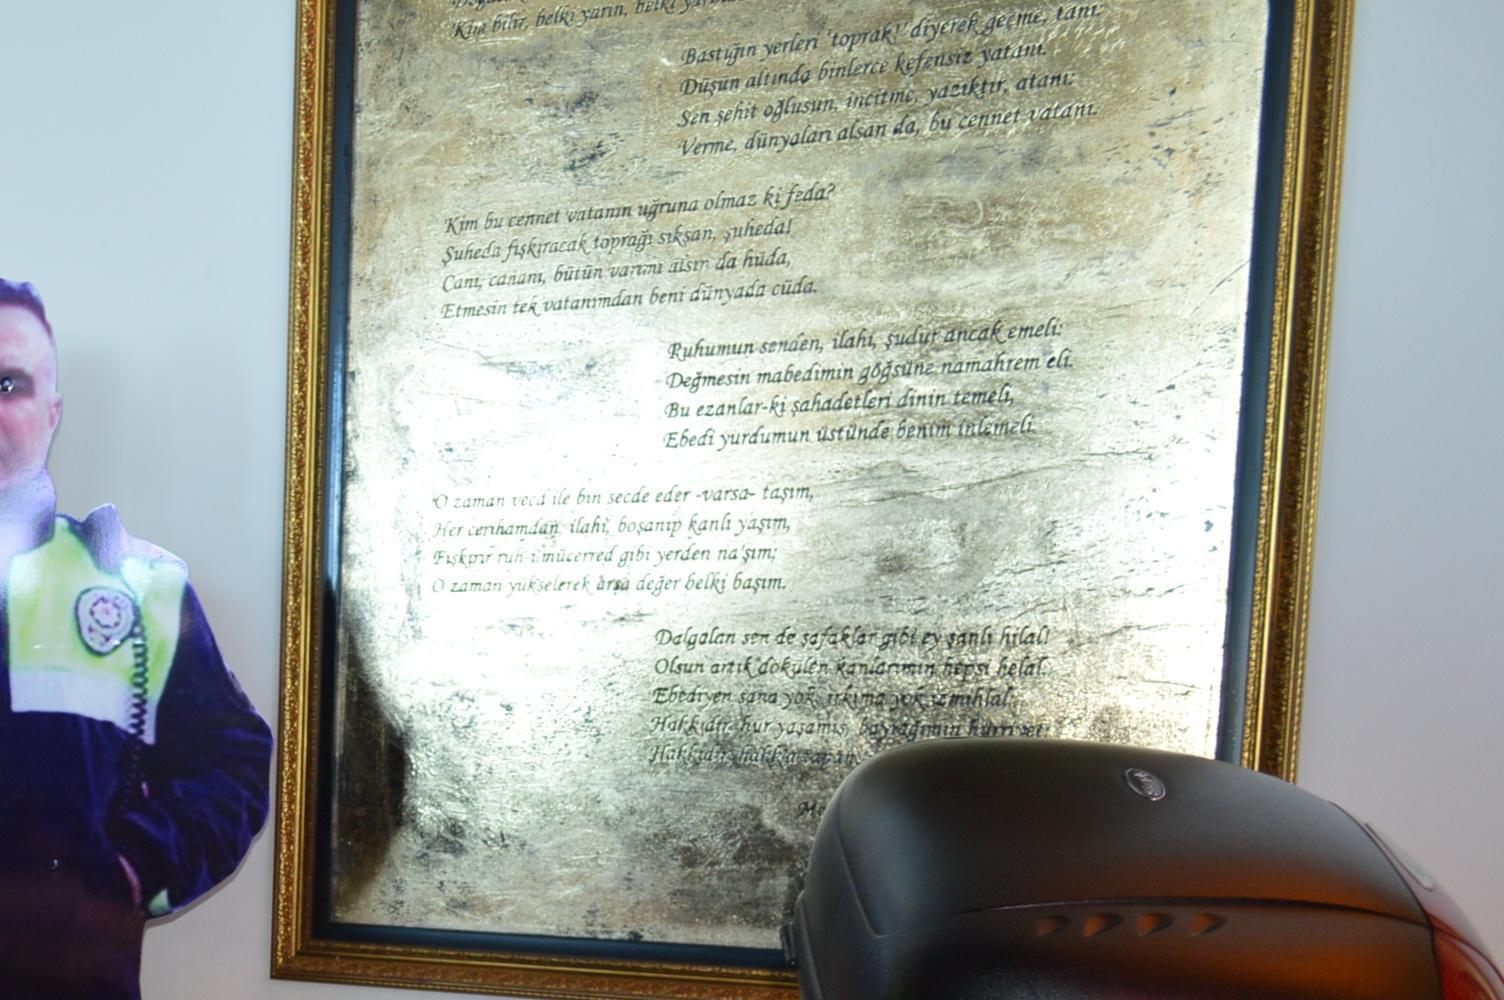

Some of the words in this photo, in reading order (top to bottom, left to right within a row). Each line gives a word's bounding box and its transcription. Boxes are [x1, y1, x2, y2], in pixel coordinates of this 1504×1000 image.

[680, 46, 757, 67] Bastığın
[762, 32, 819, 62] yerleri
[910, 12, 987, 43] diyerek
[981, 10, 1048, 35] geçme,
[680, 76, 740, 97] Düşün
[746, 62, 811, 88] altında
[818, 55, 889, 81] binlerce
[896, 49, 973, 77] kefensiz
[977, 42, 1046, 68] yatanı.
[677, 107, 710, 128] Sen
[715, 99, 757, 128] şehit
[763, 94, 838, 123] oğlusun,
[926, 75, 1009, 107] yazıktır,
[680, 137, 737, 156] Verme,
[745, 129, 832, 153] dünyaları
[837, 118, 886, 142] alsan
[893, 114, 920, 136] da,
[929, 110, 952, 132] bu
[958, 106, 1021, 130] cennet
[1028, 99, 1098, 121] vatanı.
[445, 215, 478, 235] Kim
[484, 211, 503, 231] bu
[508, 209, 560, 228] cennet
[566, 205, 632, 223] vatanın
[638, 198, 697, 222] uğruna
[703, 190, 757, 211] olmaz
[763, 185, 784, 210] ki
[781, 181, 836, 210] feda?
[442, 240, 501, 266] Şuheda
[500, 232, 591, 263] fışkıracak
[592, 229, 653, 254] toprağı
[657, 225, 716, 247] sıksan,
[723, 216, 793, 244] şuheda!
[553, 264, 603, 283] bütün
[714, 250, 737, 271] da
[440, 300, 507, 320] Etmesin
[513, 295, 541, 317] tek
[543, 289, 644, 312] vatanımdan
[648, 286, 686, 306] beni
[689, 279, 766, 307] dünyada
[771, 274, 818, 296] cüda.
[667, 338, 754, 362] Ruhumun
[759, 332, 824, 354] senden,
[884, 325, 939, 350] şudur
[945, 320, 1007, 345] ancak
[666, 368, 750, 393] Değmesin
[757, 362, 854, 384] mabedimin
[857, 356, 935, 385] göğsüne
[941, 350, 1039, 375] namahrem
[665, 402, 690, 418] Bu
[696, 396, 787, 418] ezanlar-ki
[790, 391, 892, 417] şahadetleri
[897, 388, 946, 409] dinin
[953, 382, 1014, 406] temeli,
[717, 425, 810, 451] yurdumun
[816, 419, 890, 442] üstünde
[896, 417, 951, 440] benim
[433, 493, 449, 509] O
[453, 496, 505, 508] zaman
[512, 488, 547, 506] vecd
[552, 486, 570, 505] ile
[576, 487, 602, 505] bin
[608, 486, 650, 503] secde
[655, 484, 692, 502] eder
[763, 485, 814, 503] taşım,
[435, 521, 464, 537] Her
[618, 515, 683, 536] boşanıp
[688, 512, 732, 535] kanlı
[735, 517, 791, 536] yaşım,
[617, 545, 650, 567] gibi
[653, 543, 710, 567] yerden
[432, 578, 445, 592] O
[450, 580, 502, 592] zaman
[505, 576, 594, 598] yükselerek
[636, 574, 681, 595] değer
[685, 572, 726, 595] belki
[732, 571, 786, 594] başım.
[655, 627, 736, 650] Dalgalan
[741, 634, 769, 645] sen
[776, 627, 796, 645] de
[801, 626, 878, 650] şafaklar
[880, 627, 915, 649] gibi
[922, 631, 941, 651] ey
[946, 626, 992, 649] şanlı
[655, 656, 704, 674] Olsun
[711, 656, 756, 678] artık
[758, 656, 829, 679] dökülen
[943, 657, 990, 681] hepsi
[653, 685, 732, 709] Ebediyen
[738, 691, 777, 704] sana
